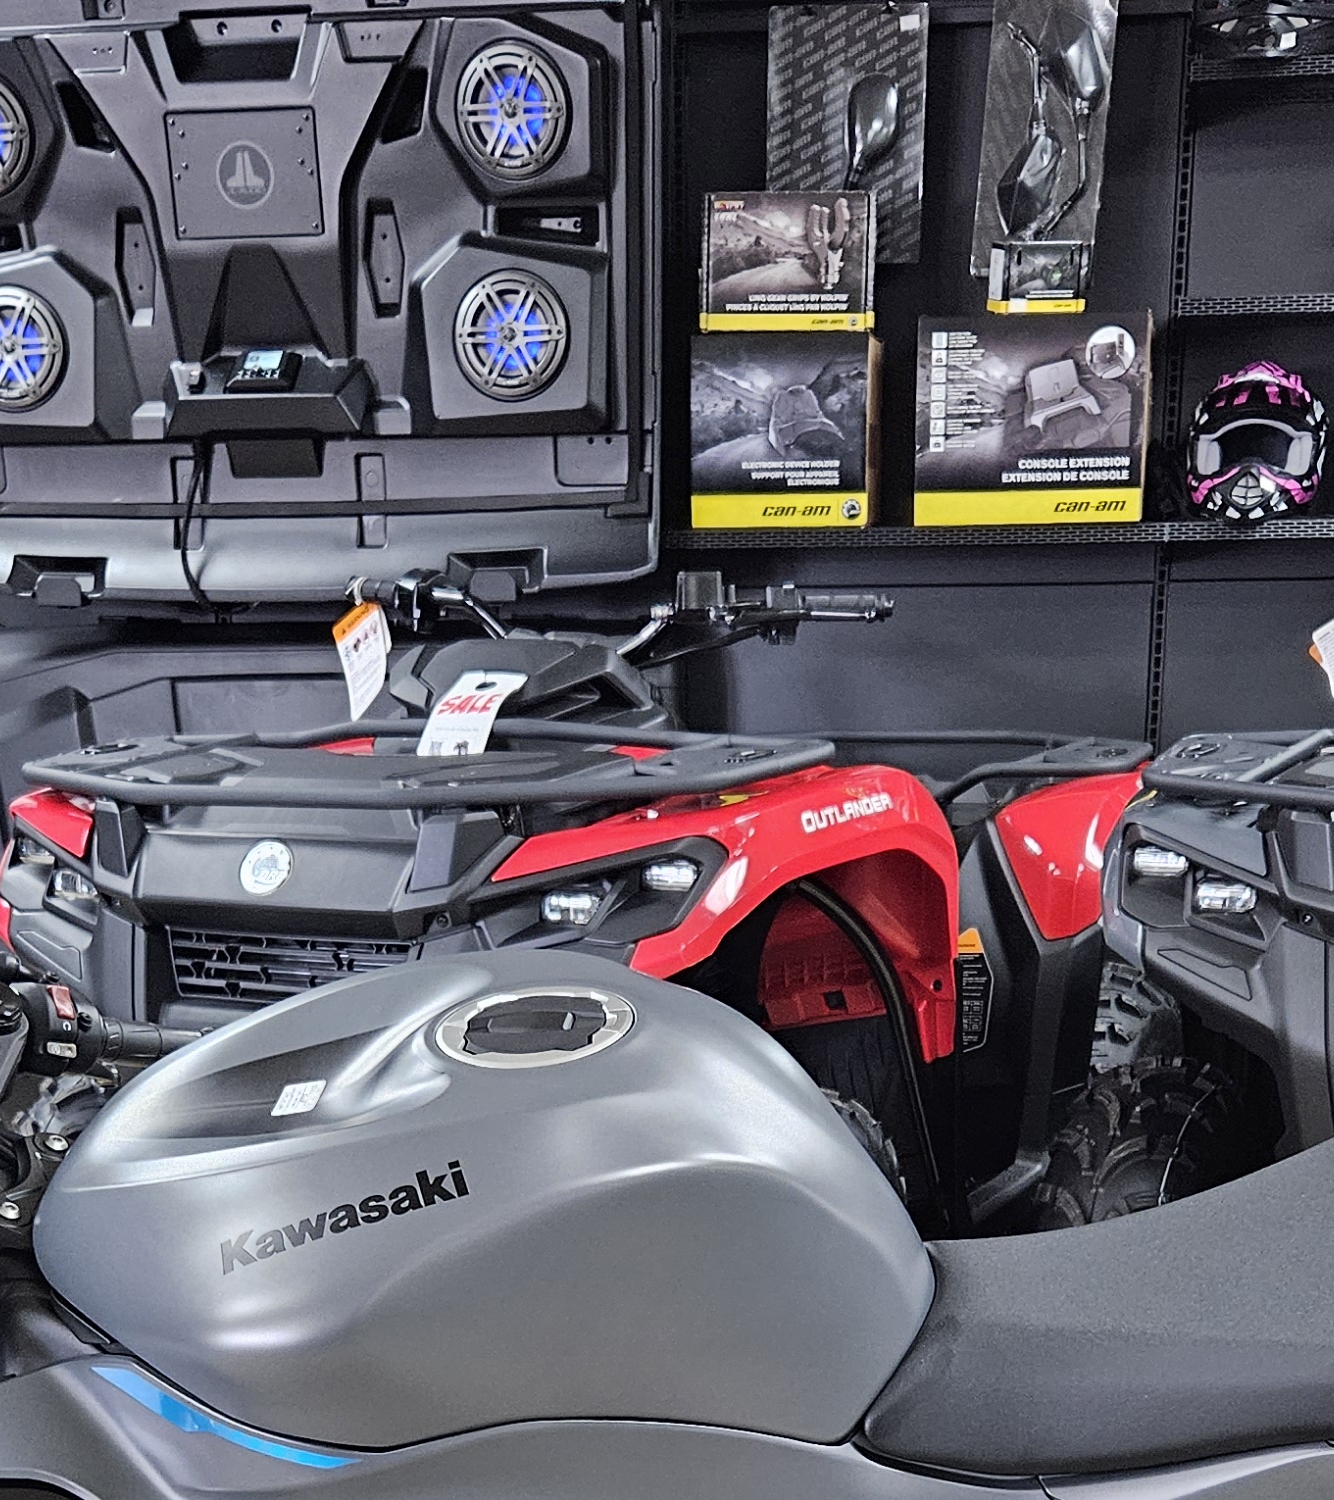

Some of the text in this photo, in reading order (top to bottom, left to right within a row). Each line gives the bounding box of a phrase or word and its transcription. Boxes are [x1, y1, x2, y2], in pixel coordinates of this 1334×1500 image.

[1018, 456, 1130, 470] CONSOLE EXTENSION
[1002, 469, 1130, 483] EXTENSION DE CONSOLE
[762, 505, 832, 517] can-am
[1054, 500, 1126, 513] can-am
[436, 693, 504, 716] SALE
[800, 792, 894, 834] OUTLANDER
[218, 1158, 471, 1276] Kawasaki
